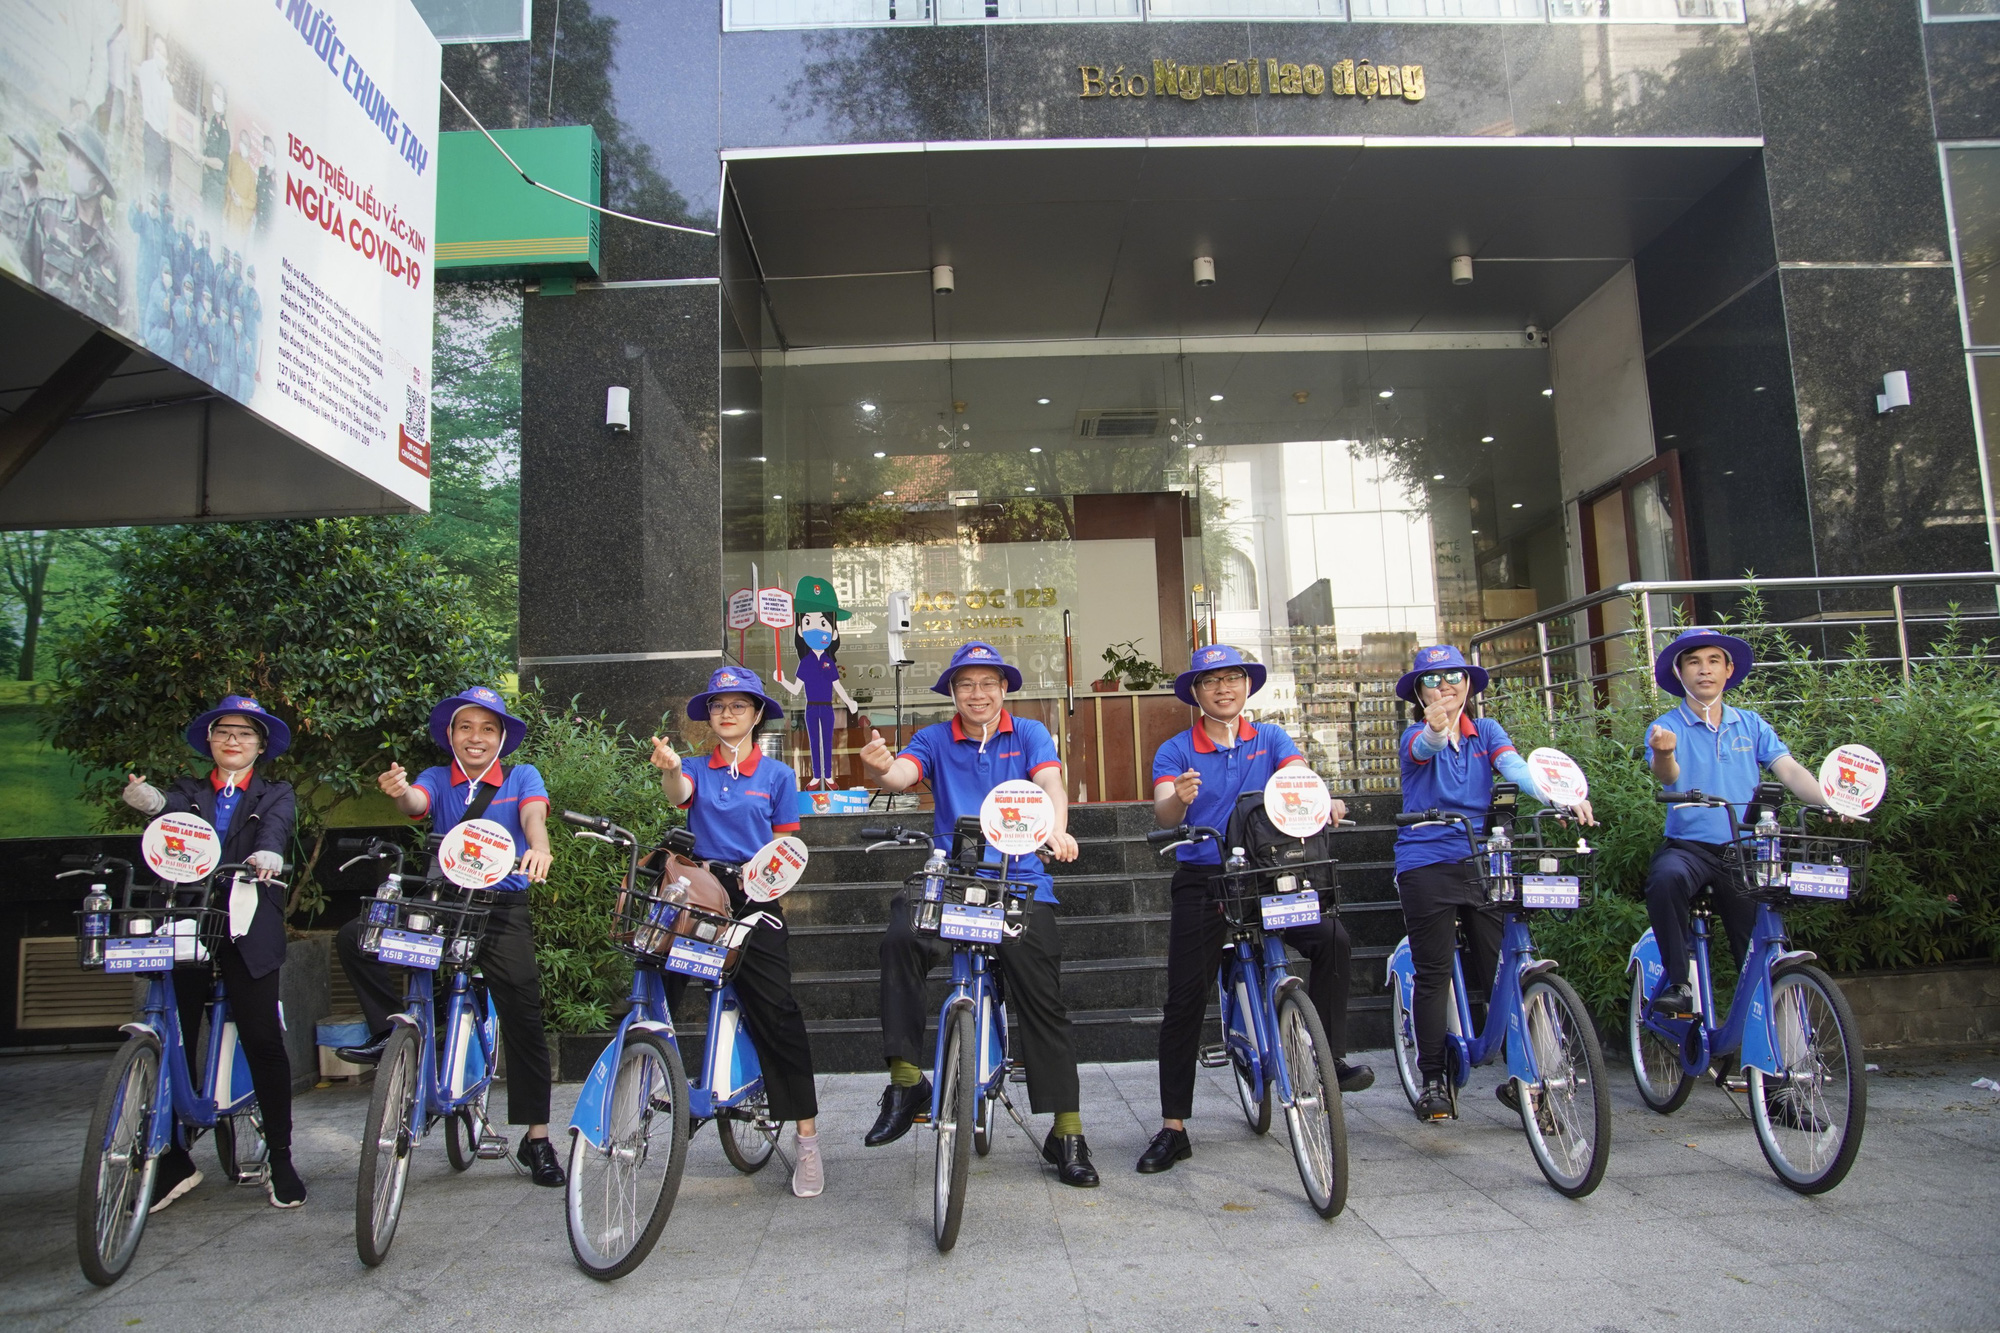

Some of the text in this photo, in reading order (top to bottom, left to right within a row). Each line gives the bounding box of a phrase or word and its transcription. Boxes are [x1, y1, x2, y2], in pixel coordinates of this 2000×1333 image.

[1078, 57, 1425, 101] Báo Người lao động
[343, 54, 399, 145] CHUNG
[400, 122, 428, 176] TAY
[288, 132, 426, 255] 150 TRIỆU LIỀU VẮC-XIN
[285, 171, 421, 290] NGỪA COVID-19
[282, 257, 293, 275] Mọi
[294, 269, 300, 281] sự
[301, 273, 314, 293] đóng
[314, 286, 325, 299] góp
[281, 274, 296, 294] Ngân
[297, 286, 310, 307] hàng
[311, 297, 325, 315] TMCP
[280, 294, 298, 313] nhánh
[299, 305, 306, 317] TP
[293, 355, 309, 376] chung
[278, 362, 288, 376] 127
[380, 430, 386, 441] TP
[277, 379, 290, 396] HCM
[340, 420, 349, 433] 091
[361, 433, 370, 446] 209
[1013, 587, 1058, 608] 123
[923, 617, 1024, 631] 123 TOWER
[1550, 896, 1575, 904] 21.707
[1818, 885, 1845, 895] 21.444
[1291, 912, 1317, 922] 21.222
[970, 928, 999, 939] 21.545
[138, 958, 166, 968] 21.001
[408, 953, 437, 966] 21.565
[692, 964, 718, 976] 21.888
